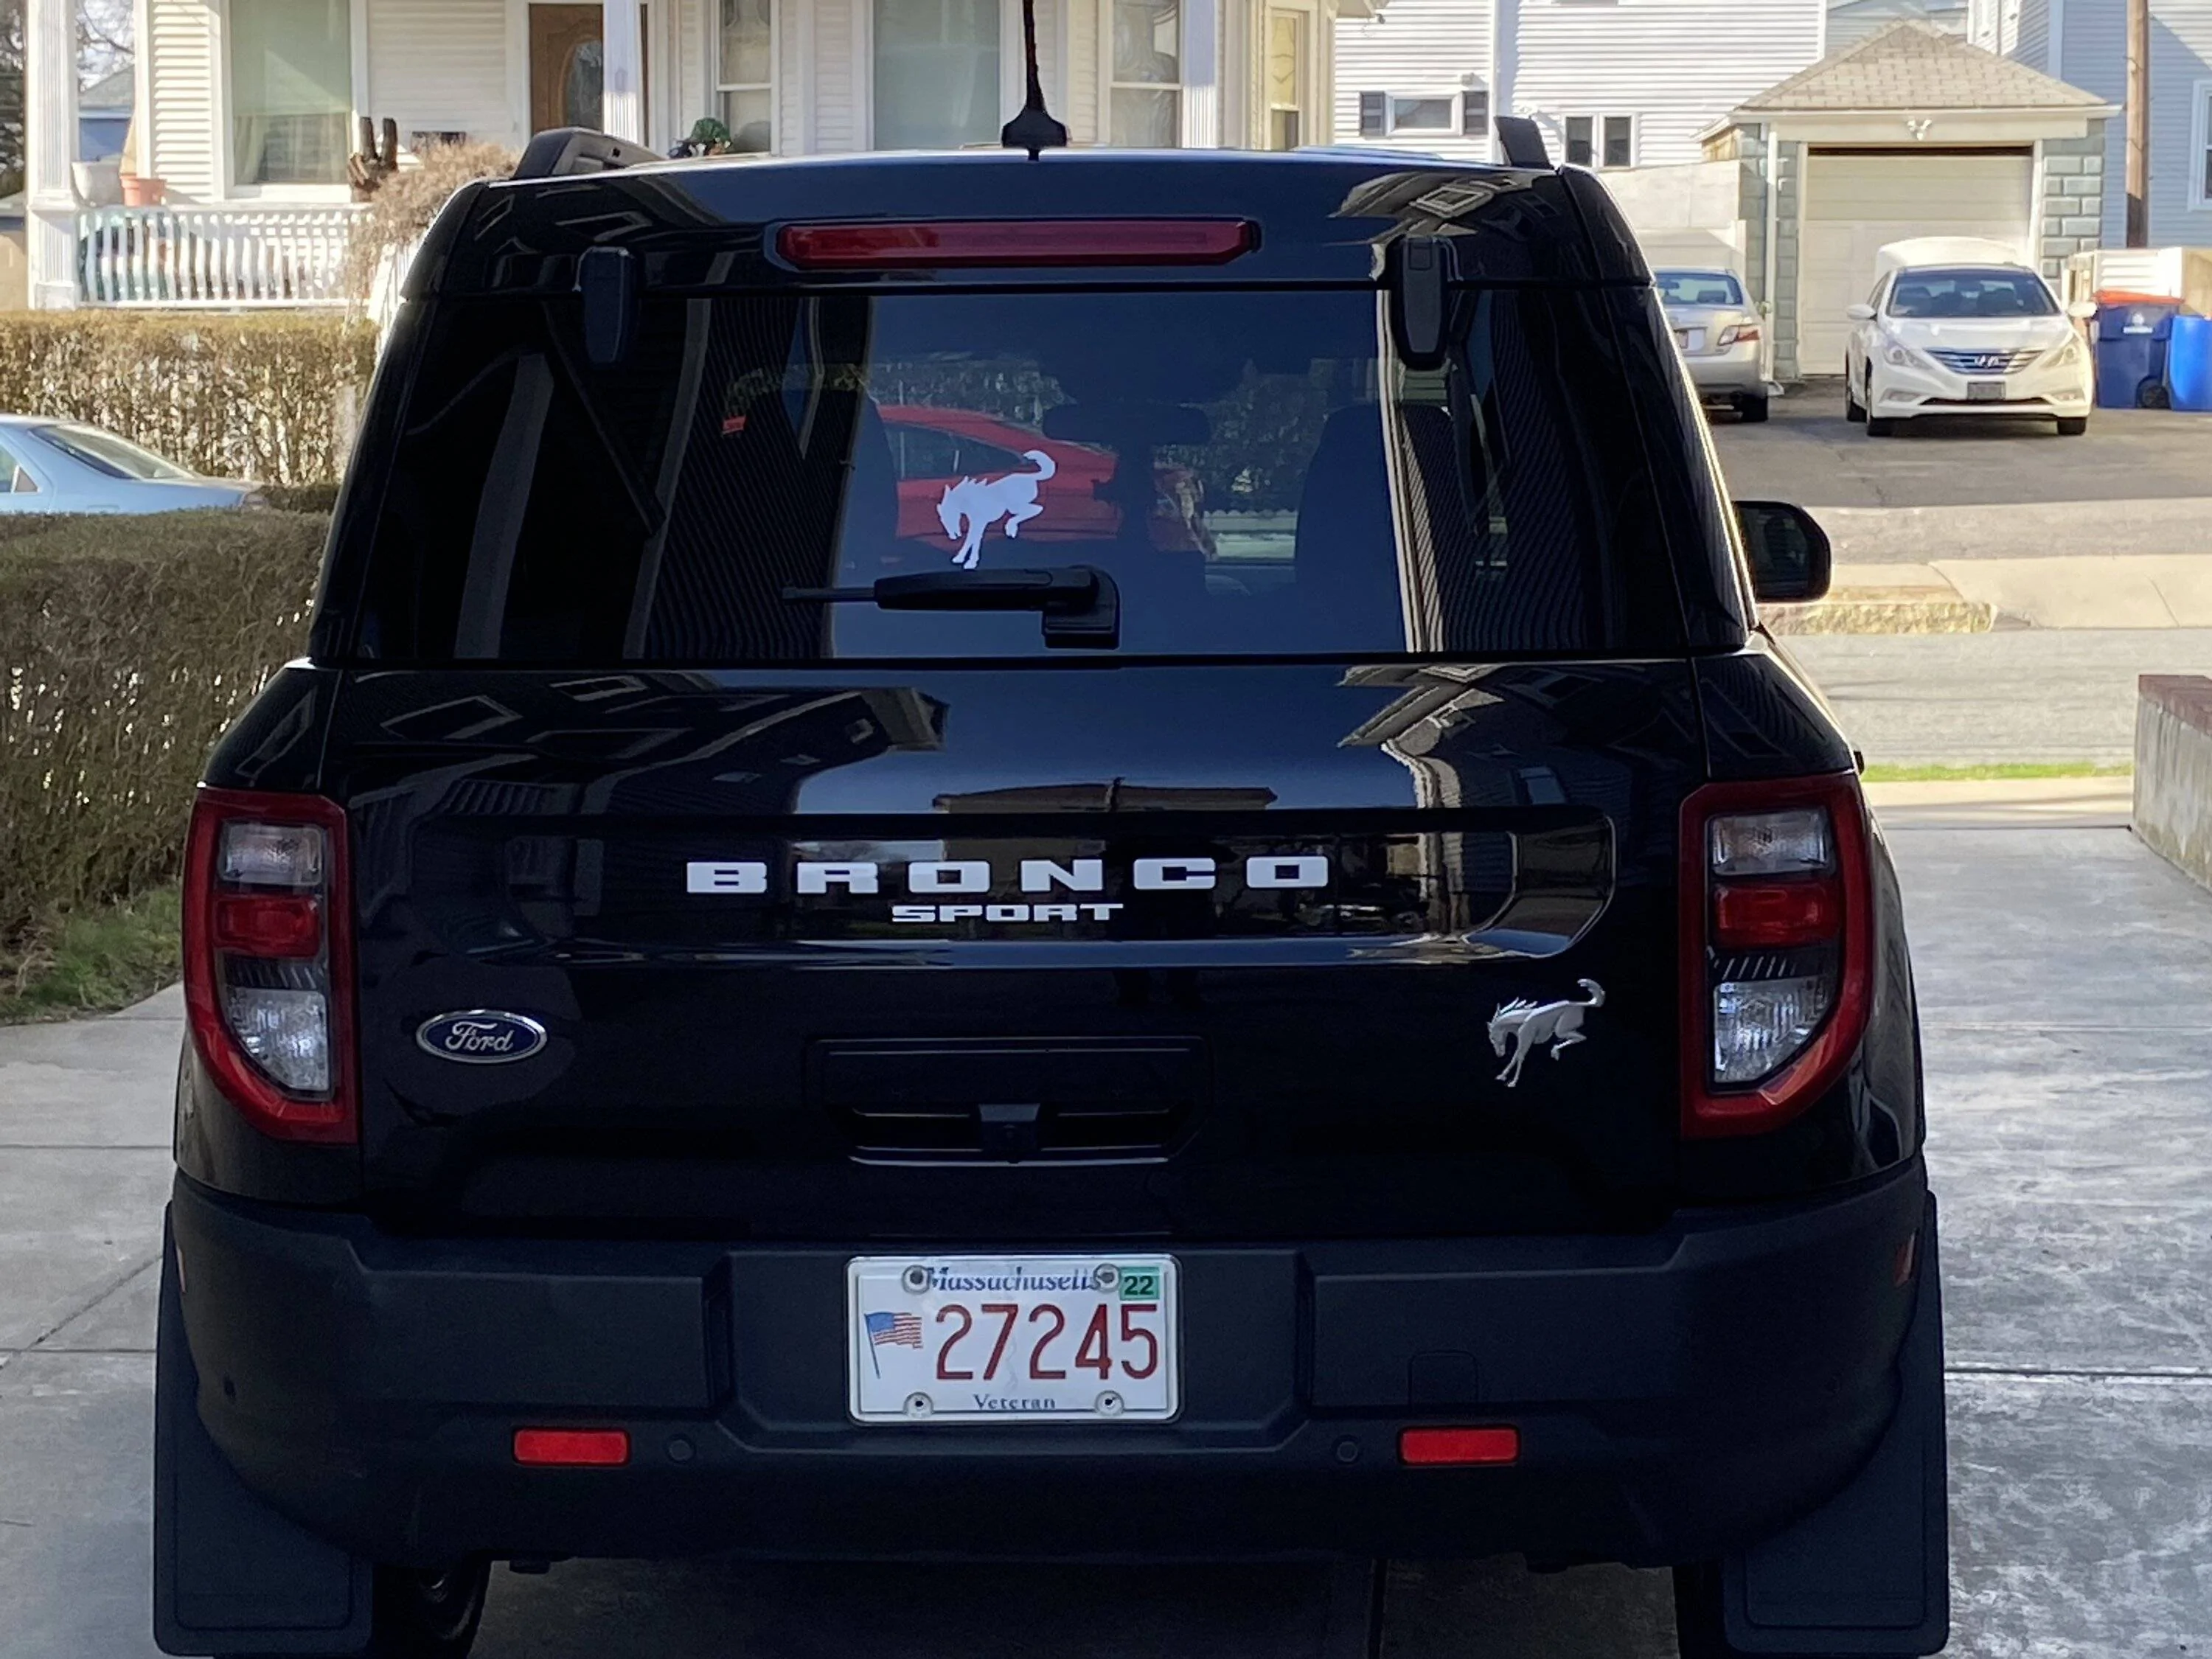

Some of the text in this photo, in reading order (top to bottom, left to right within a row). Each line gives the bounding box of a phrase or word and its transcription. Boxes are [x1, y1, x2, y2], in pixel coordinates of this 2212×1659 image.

[686, 855, 1329, 894] BRONCO
[891, 902, 1124, 922] SPORT
[445, 1020, 515, 1051] Ford
[1124, 1275, 1154, 1295] 22
[936, 1303, 1158, 1380] 27245
[973, 1393, 1056, 1410] Veteran
